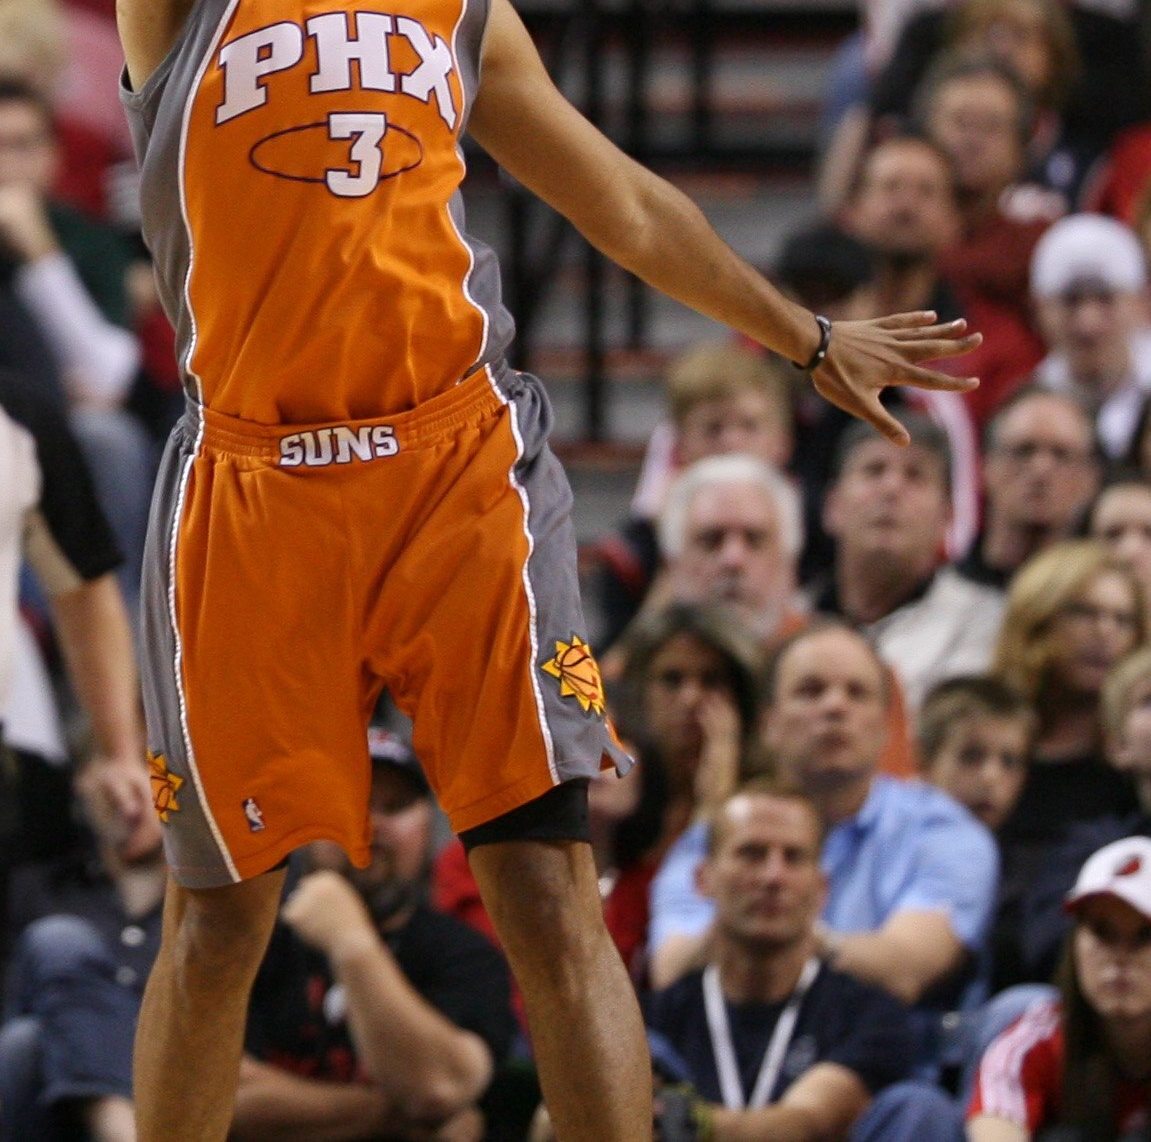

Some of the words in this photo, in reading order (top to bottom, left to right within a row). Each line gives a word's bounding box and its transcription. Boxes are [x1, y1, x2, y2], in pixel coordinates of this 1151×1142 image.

[215, 10, 457, 132] PHX
[325, 111, 387, 199] 3
[279, 425, 399, 467] SUNS
